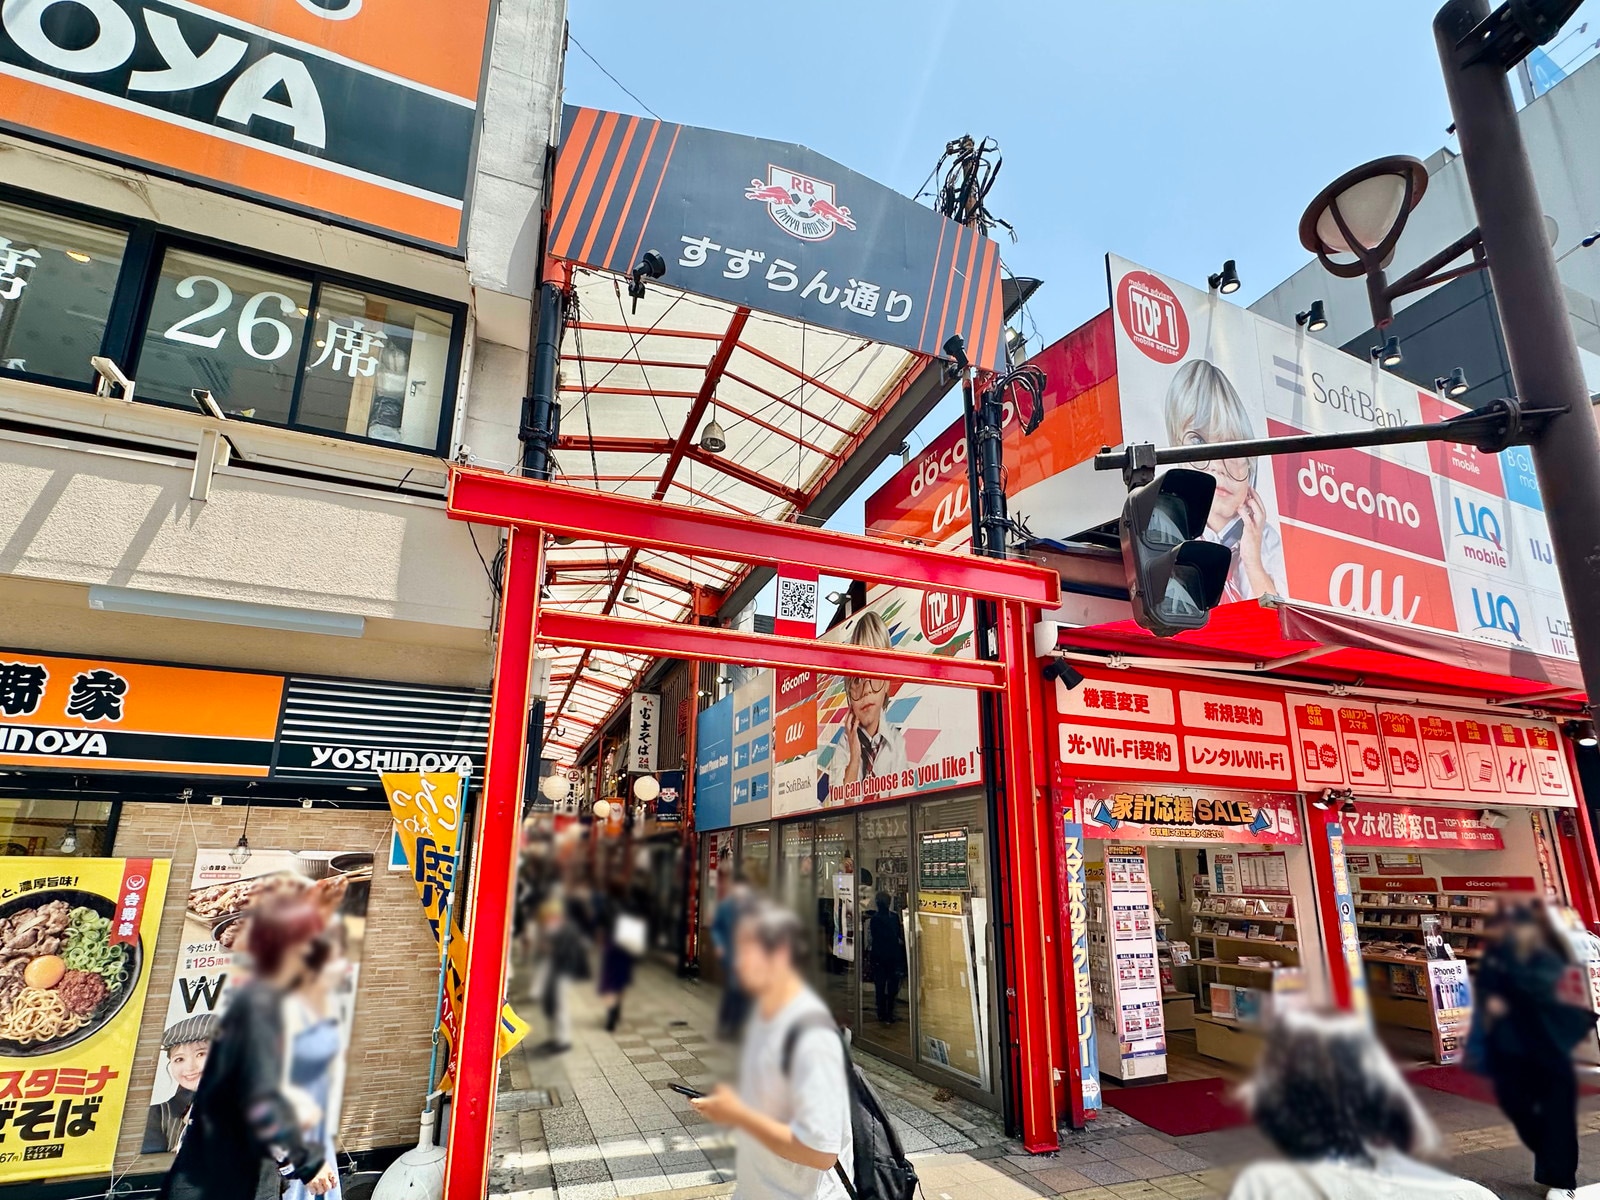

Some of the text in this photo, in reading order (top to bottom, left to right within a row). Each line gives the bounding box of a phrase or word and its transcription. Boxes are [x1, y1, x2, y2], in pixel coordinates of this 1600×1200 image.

[791, 175, 815, 195] RB
[775, 208, 800, 232] OMIYA
[679, 235, 914, 324] すずらん通り
[1131, 290, 1176, 346] TOP 1
[1133, 335, 1180, 357] mobile adviser
[1311, 371, 1408, 429] SoftBank
[924, 450, 938, 467] NTT
[1317, 461, 1336, 476] NTT
[1451, 456, 1481, 476] mobile
[1297, 457, 1421, 530] docomo
[1454, 496, 1503, 552] UQ
[1464, 544, 1507, 569] mobile
[1328, 562, 1421, 624] au
[928, 591, 948, 630] TOP
[1471, 586, 1522, 643] UQ
[780, 671, 810, 695] docomo
[1083, 687, 1151, 714] 機種変更
[1203, 701, 1264, 727] 新規契約
[1308, 716, 1324, 727] SIM
[1348, 720, 1369, 731] スマホ
[637, 707, 652, 756] 富士そば
[785, 720, 805, 744] au
[1391, 724, 1406, 734] SIM
[1422, 727, 1452, 738] アクセサリー
[311, 746, 474, 774] YOSHINOYA
[1067, 733, 1172, 762] 光・Wi-Fi契約
[1191, 745, 1285, 772] レンタルWi-Fi
[785, 776, 812, 794] SoftBank
[828, 751, 975, 802] You can choose as you like !
[1111, 792, 1256, 824] 家計応援 SALE
[118, 892, 140, 937] 吉野家
[187, 943, 218, 954] 今だけ!
[193, 956, 231, 969] 125周
[1433, 965, 1455, 976] iPhone
[179, 973, 227, 1014] W
[0, 1065, 120, 1100] スタミナ
[26, 1145, 63, 1155] テイクアウト
[26, 1152, 51, 1161] できます
